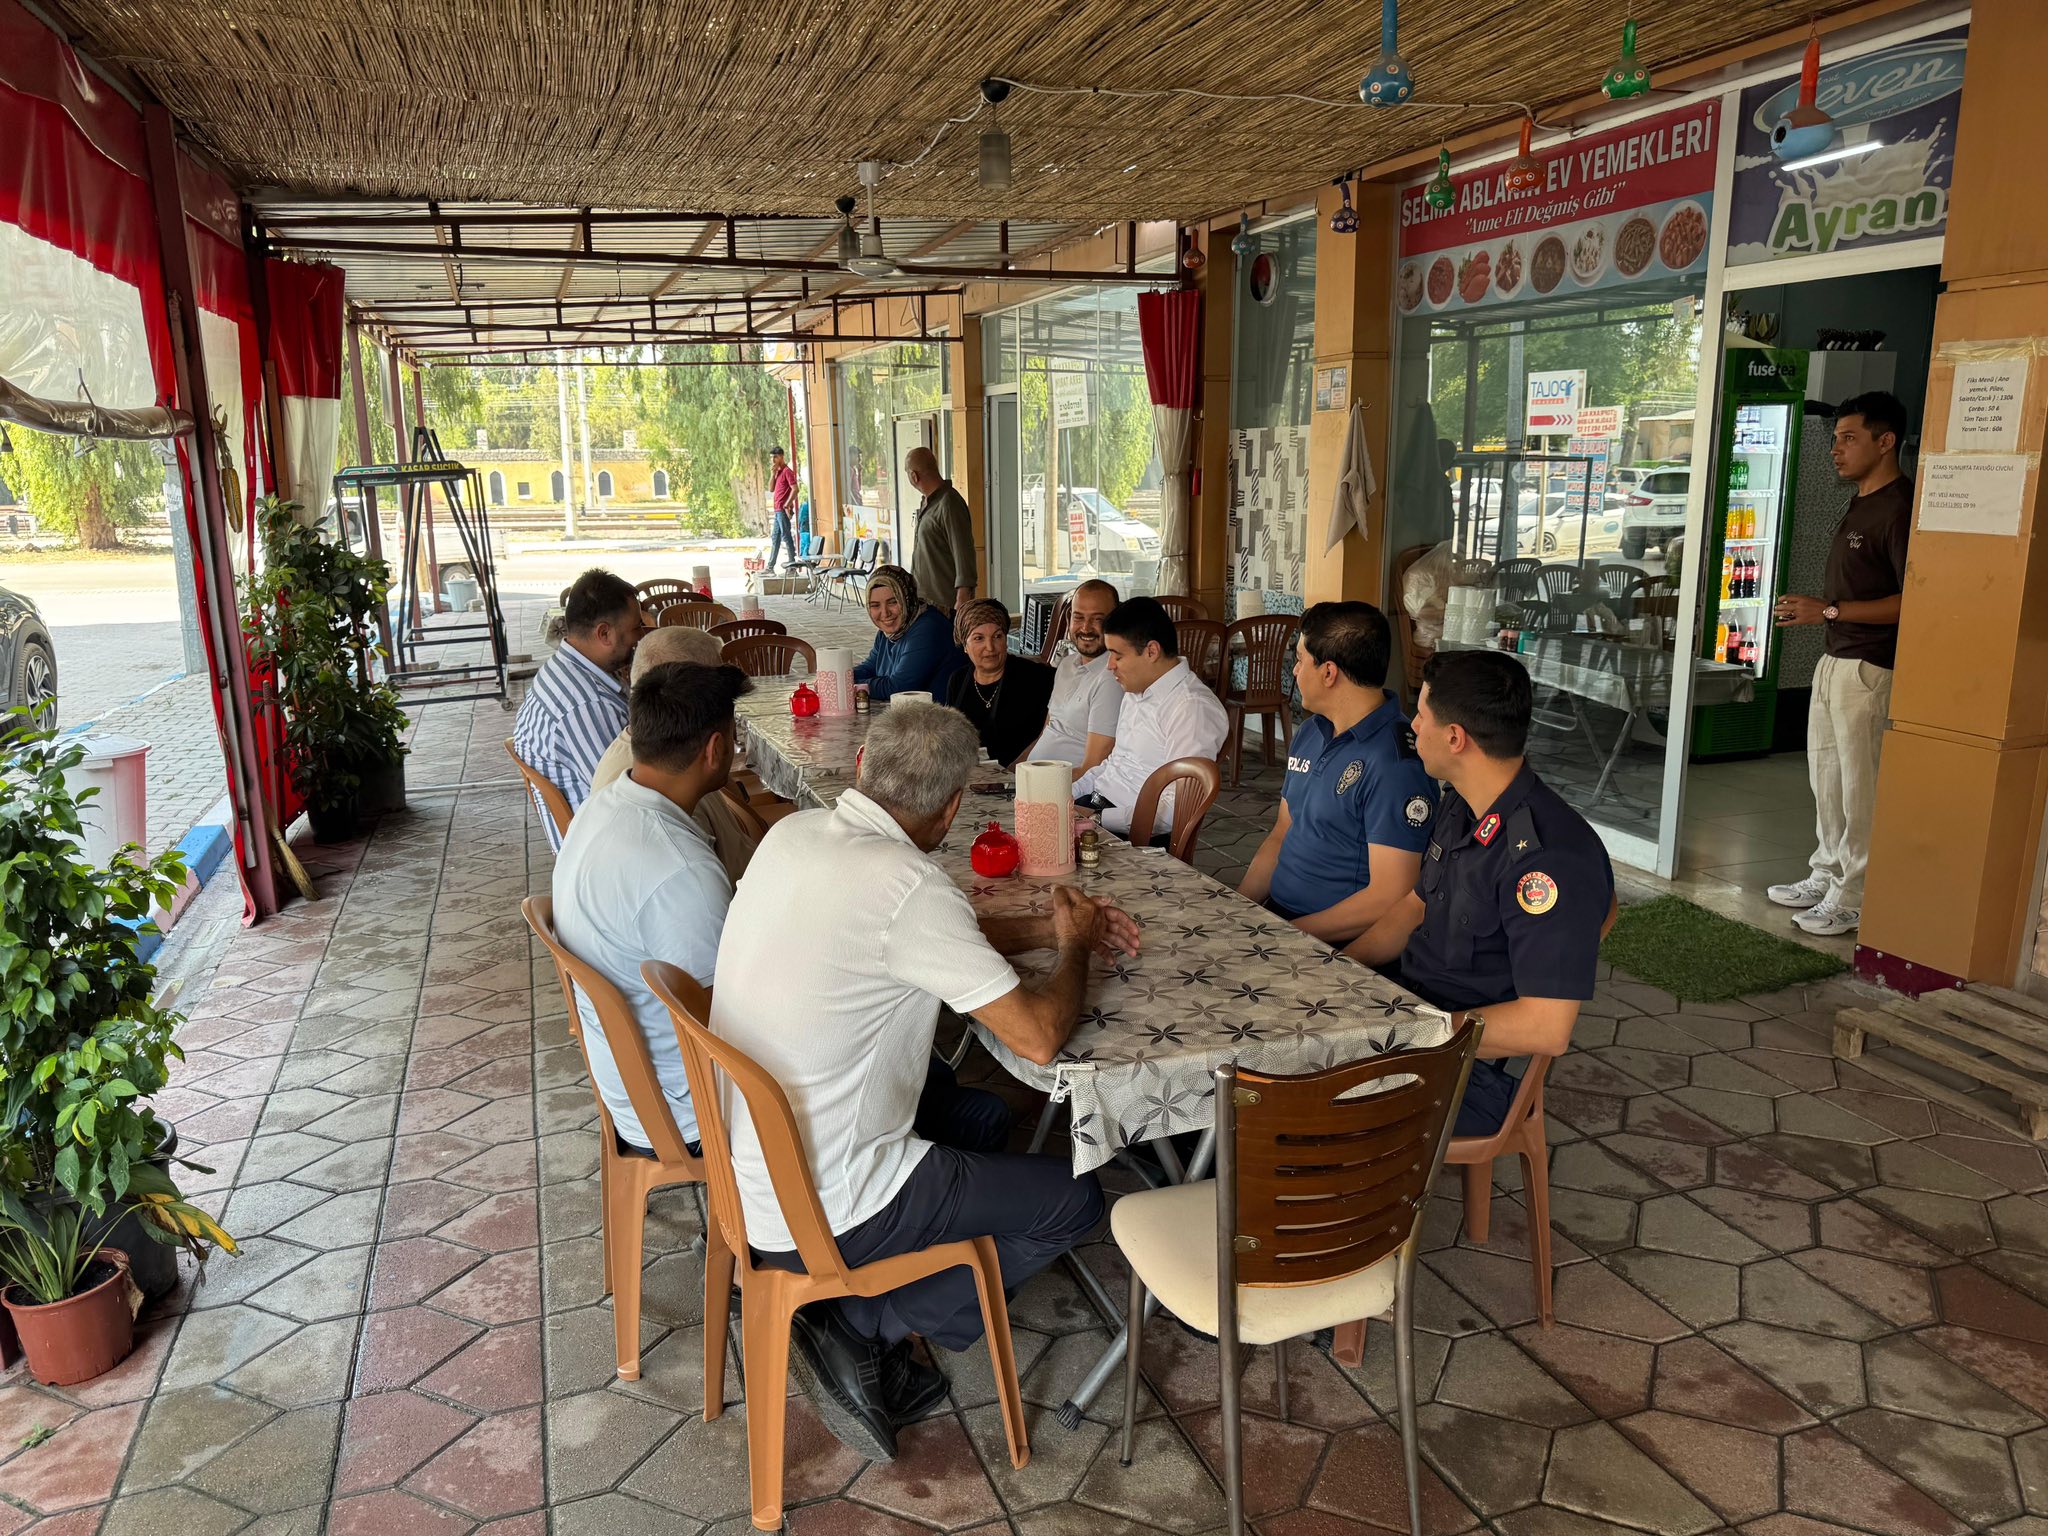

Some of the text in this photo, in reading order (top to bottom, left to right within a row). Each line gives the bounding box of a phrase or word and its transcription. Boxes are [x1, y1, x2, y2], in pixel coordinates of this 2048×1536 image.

[1402, 105, 1714, 227] SEL ABLA EV YEMEKLERİ
[1504, 206, 1523, 227] Eli
[1524, 195, 1581, 224] Değmiş
[1770, 190, 1939, 253] Ayran
